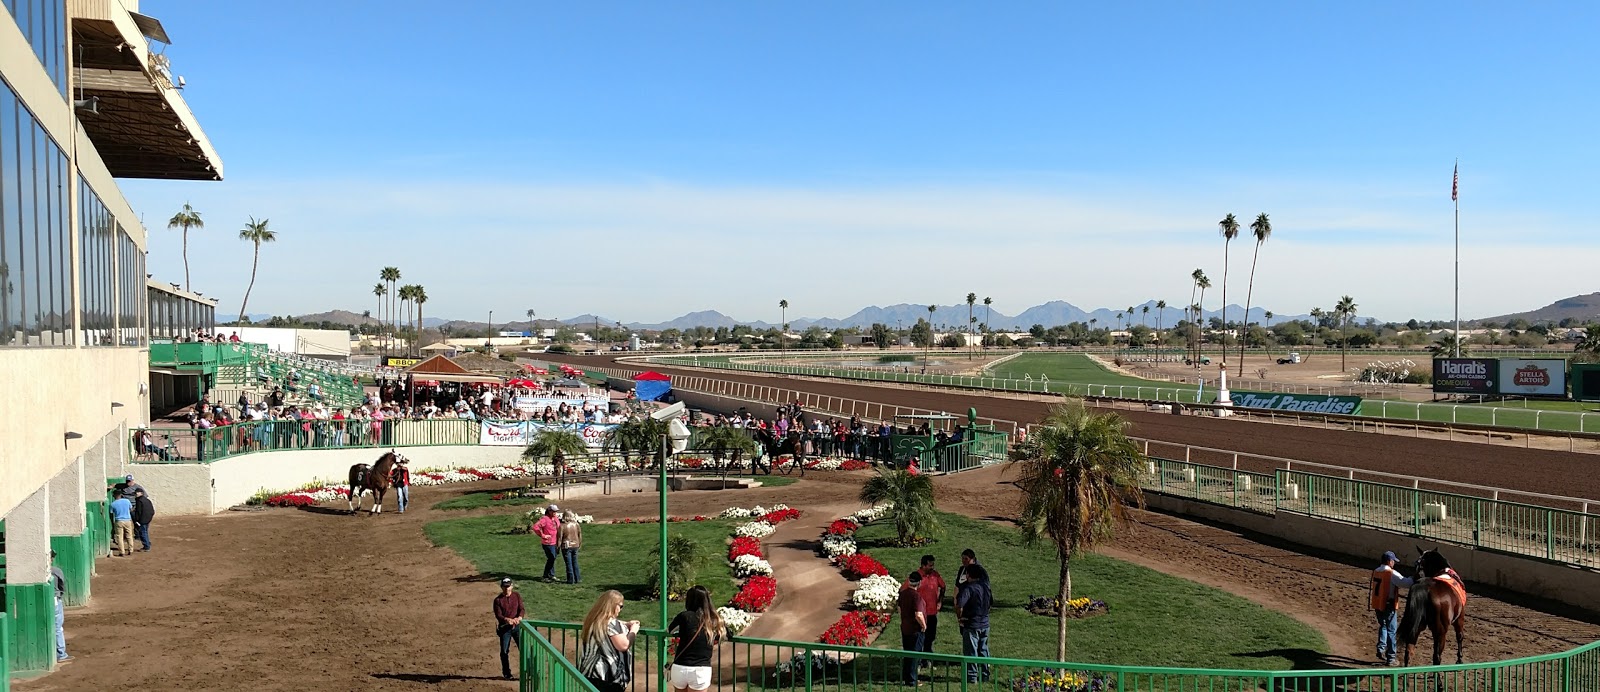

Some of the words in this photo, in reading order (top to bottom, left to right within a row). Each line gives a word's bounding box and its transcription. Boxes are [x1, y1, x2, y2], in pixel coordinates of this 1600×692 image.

[1243, 394, 1280, 409] Turf
[1279, 395, 1355, 414] Paradise
[357, 471, 364, 482] 6
[1373, 577, 1382, 596] 7
